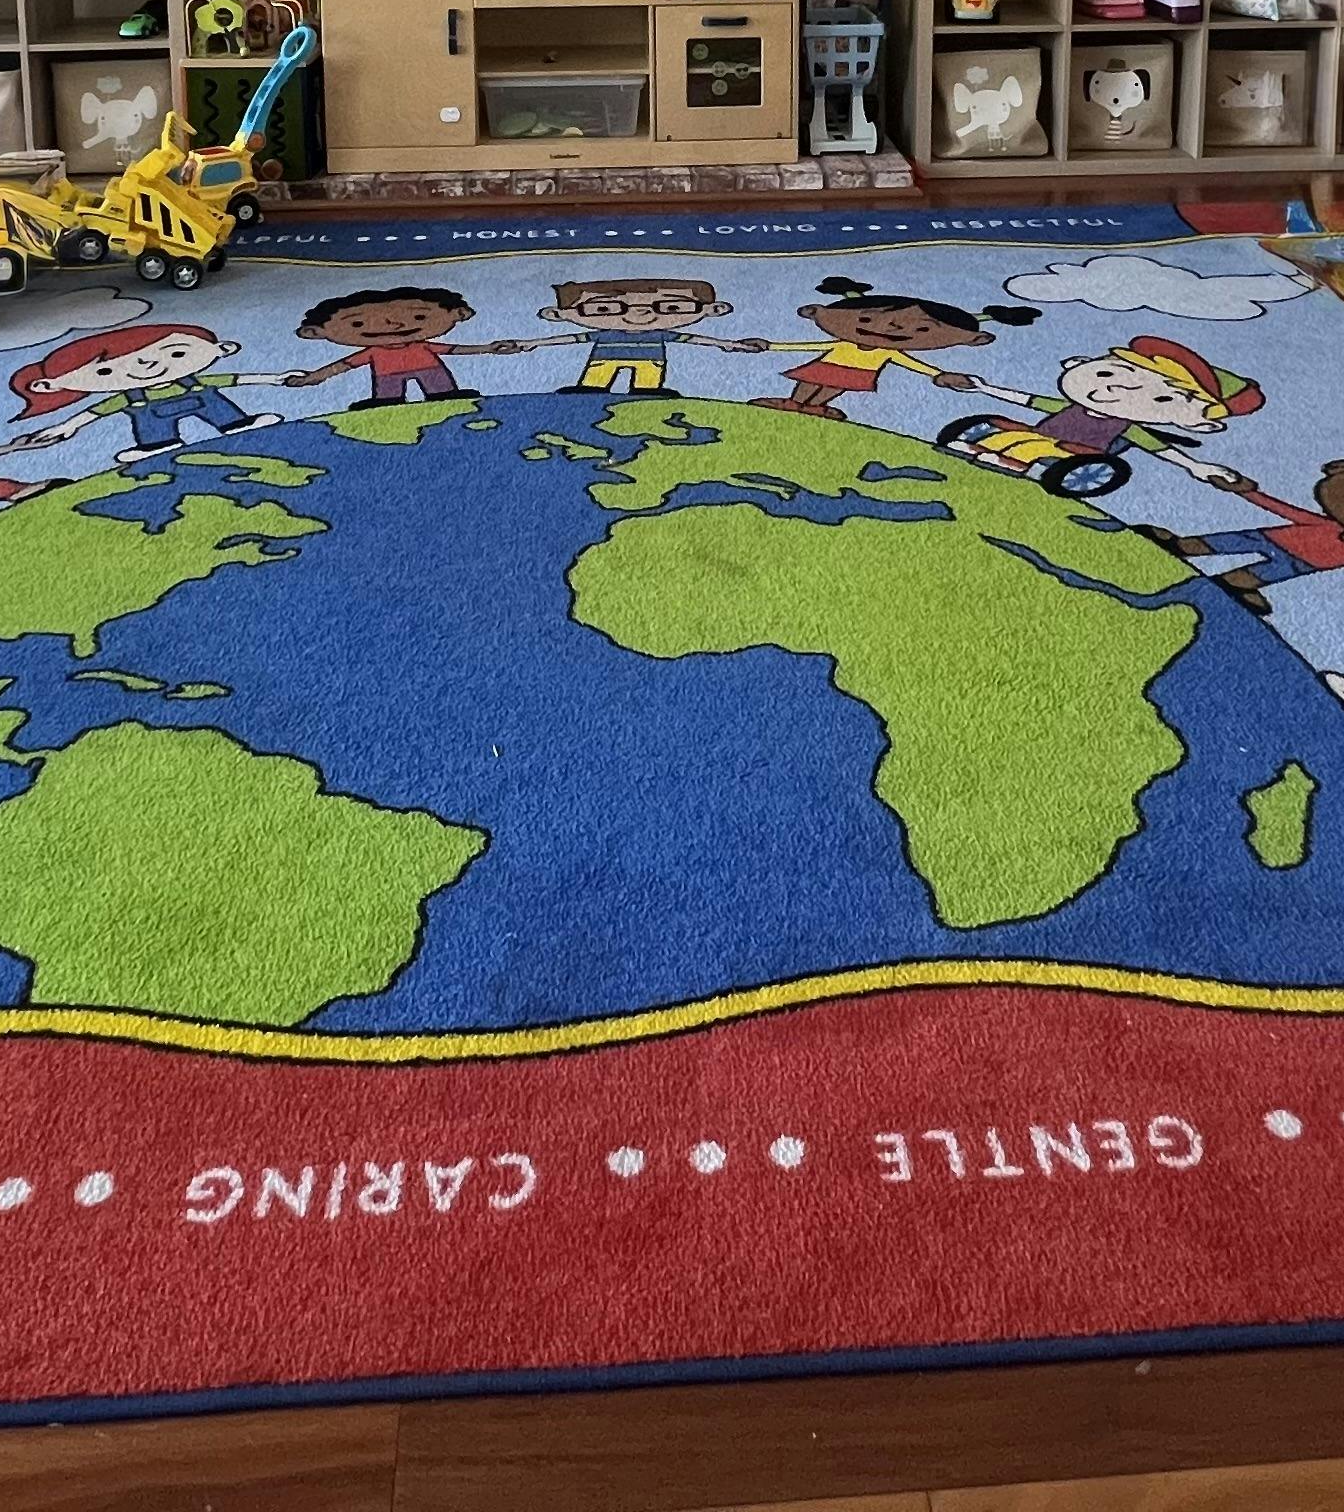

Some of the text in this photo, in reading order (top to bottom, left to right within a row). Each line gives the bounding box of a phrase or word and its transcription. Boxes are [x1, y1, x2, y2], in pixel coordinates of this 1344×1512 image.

[236, 215, 1124, 245] LPFUL HONEST LOVING RESPECTFUL
[874, 1114, 1204, 1182] GENTLE
[184, 1151, 537, 1224] CARING
